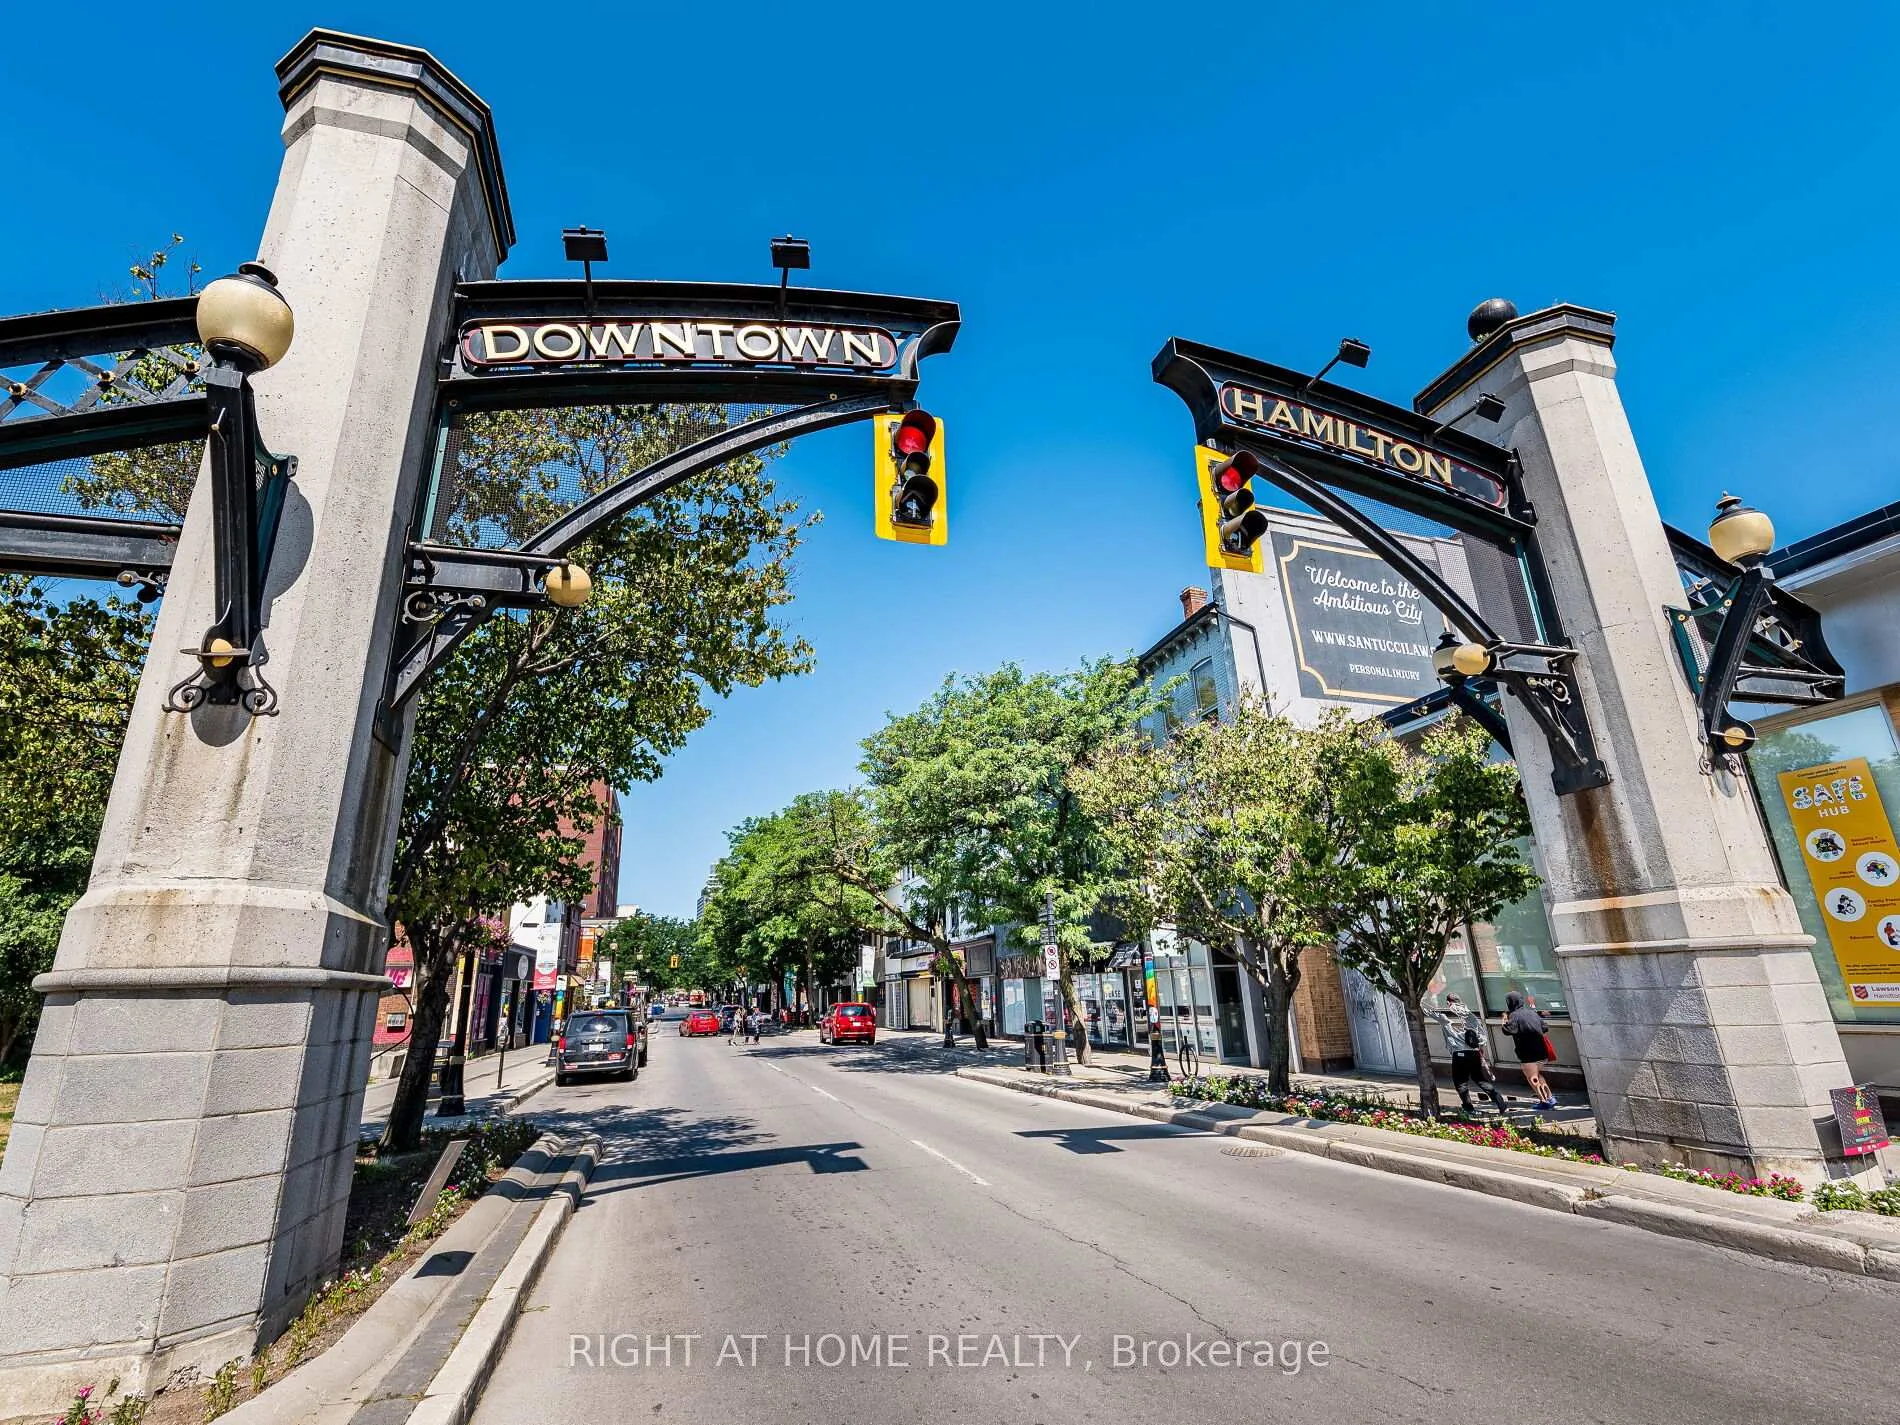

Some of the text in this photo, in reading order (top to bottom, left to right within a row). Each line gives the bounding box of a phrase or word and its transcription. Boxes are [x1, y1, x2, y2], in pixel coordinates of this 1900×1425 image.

[480, 322, 883, 366] DOWNTOWN
[1232, 388, 1453, 485] HAMILTON
[1305, 565, 1421, 600] Welcome to the
[1313, 589, 1423, 625] Ambitious City
[1349, 664, 1420, 681] PERSONAL INJURY
[1792, 775, 1867, 809] SAFE
[1819, 806, 1850, 818] HUB
